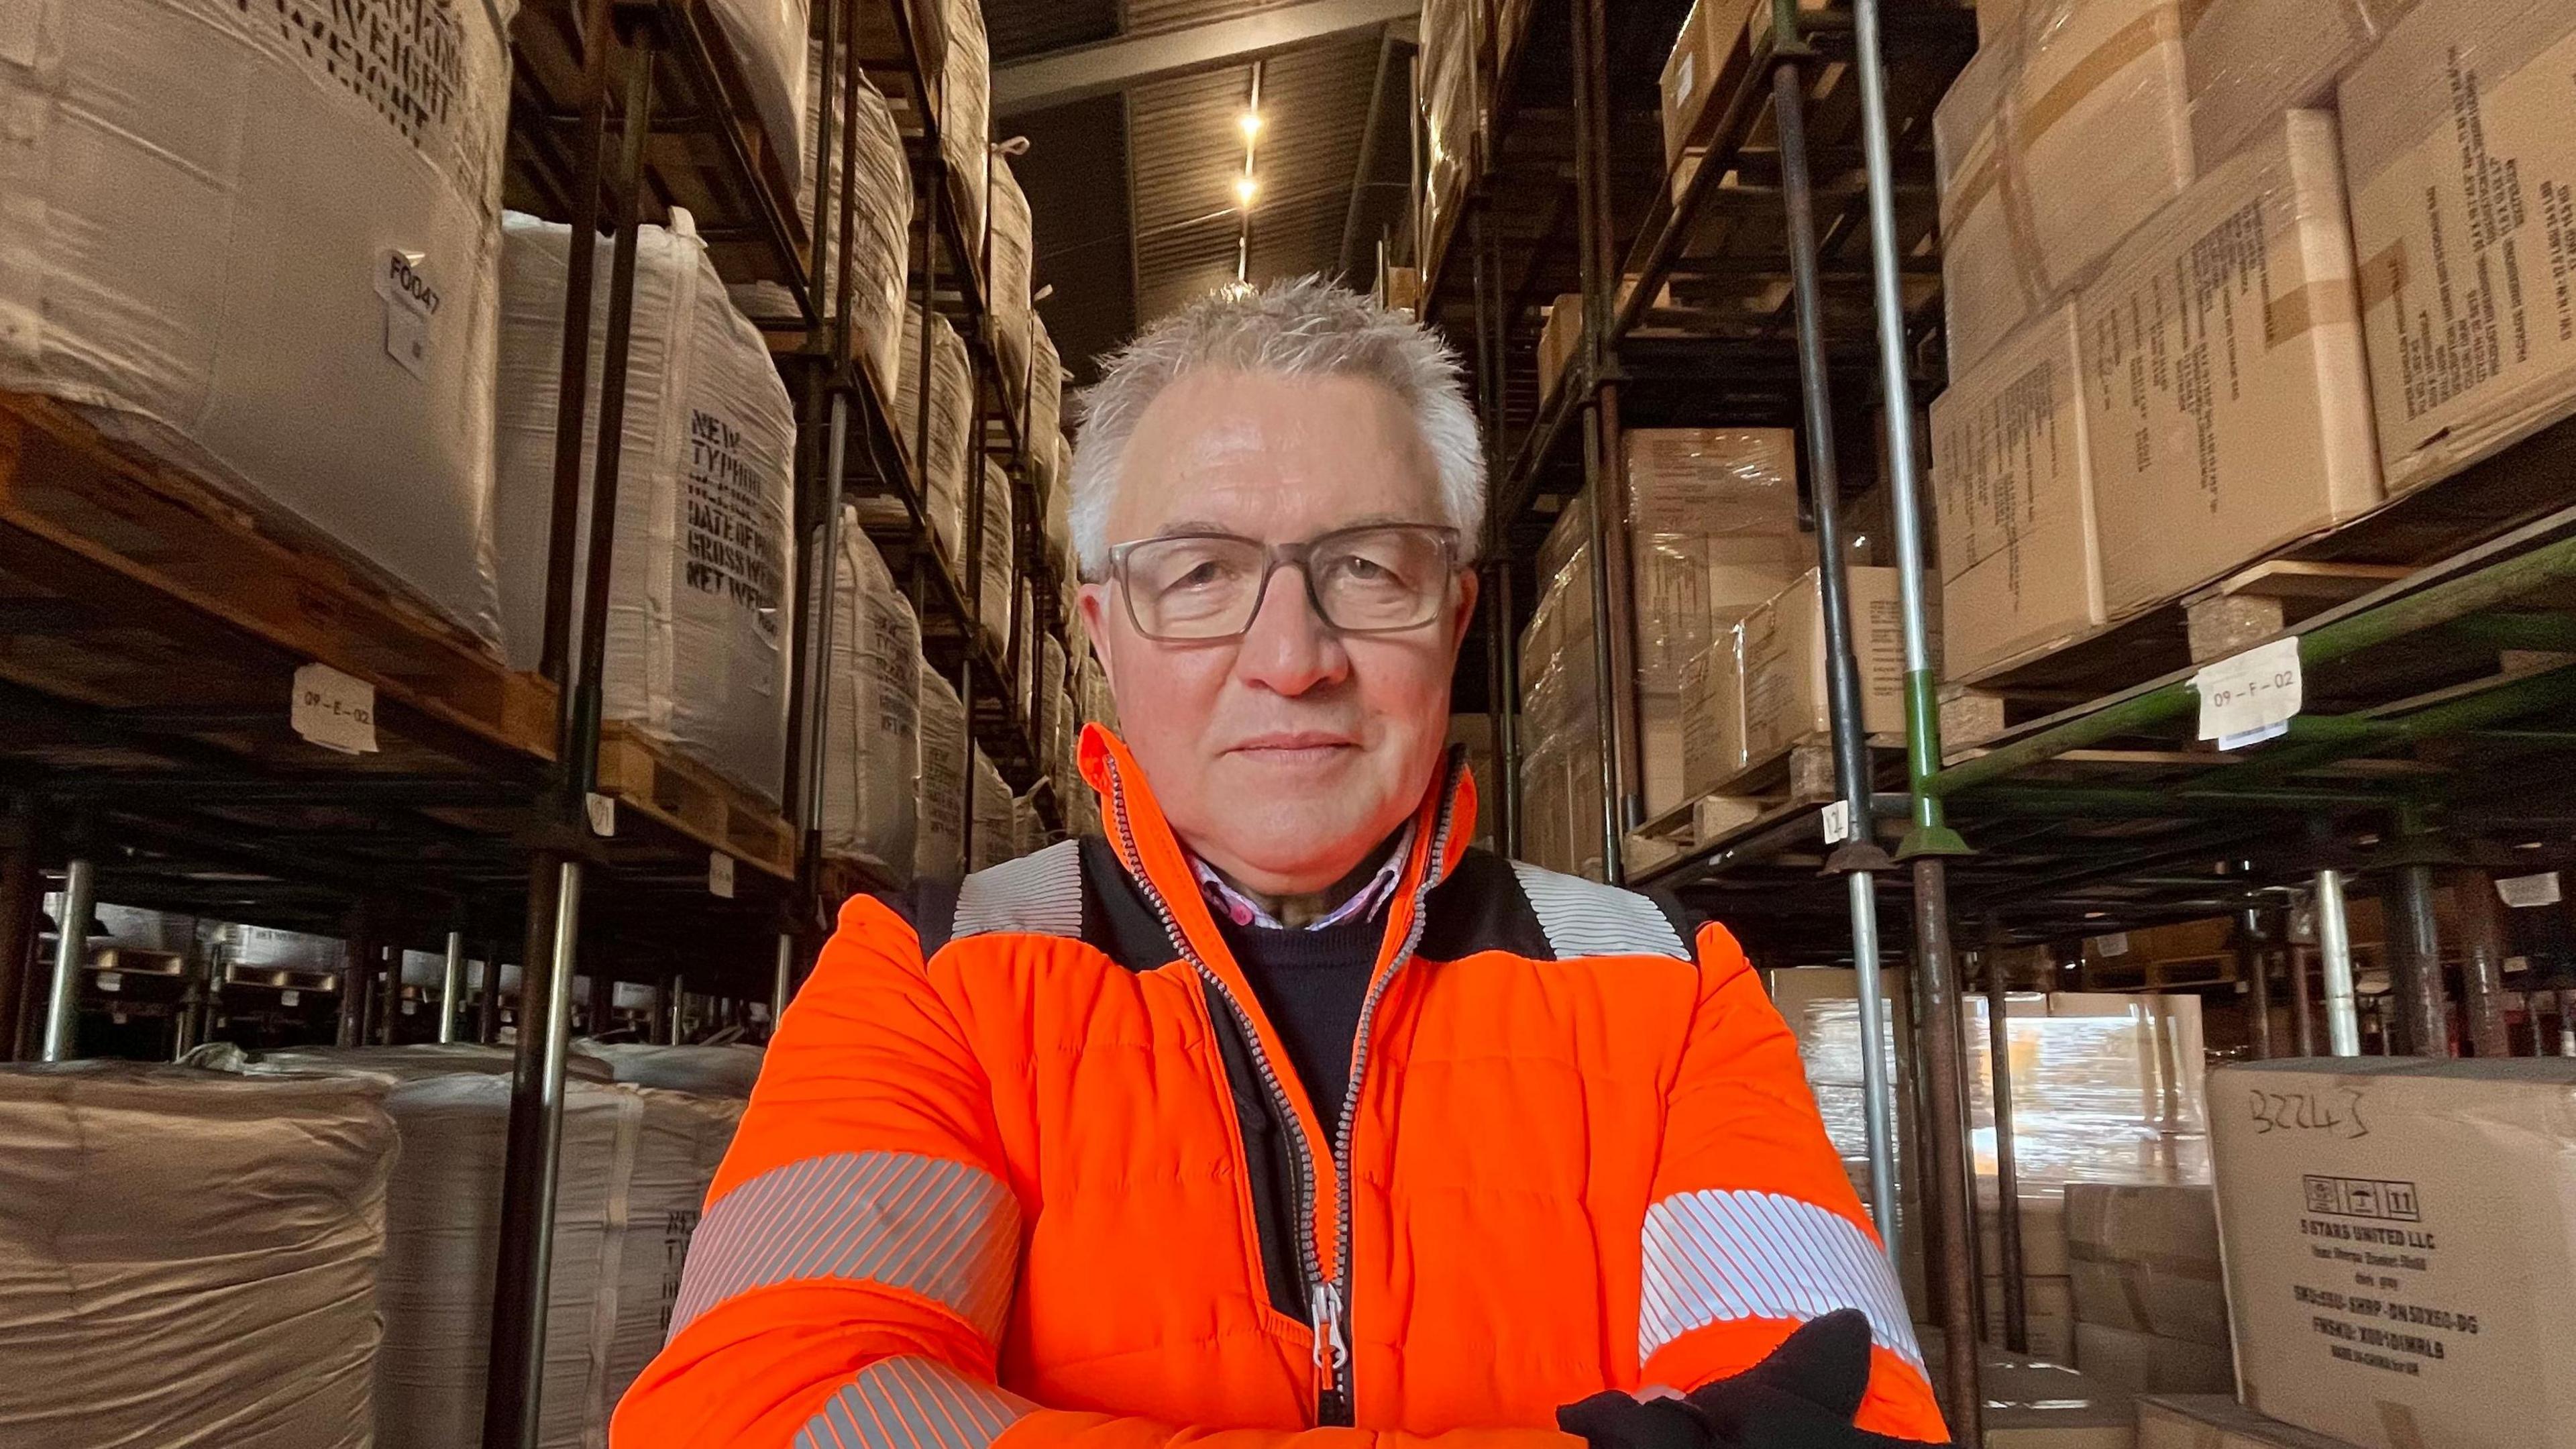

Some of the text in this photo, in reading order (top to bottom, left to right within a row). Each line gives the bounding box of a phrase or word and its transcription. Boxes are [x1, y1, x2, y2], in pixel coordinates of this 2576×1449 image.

[390, 256, 440, 315] F0047
[2214, 690, 2231, 707] 09
[2274, 671, 2295, 689] 02
